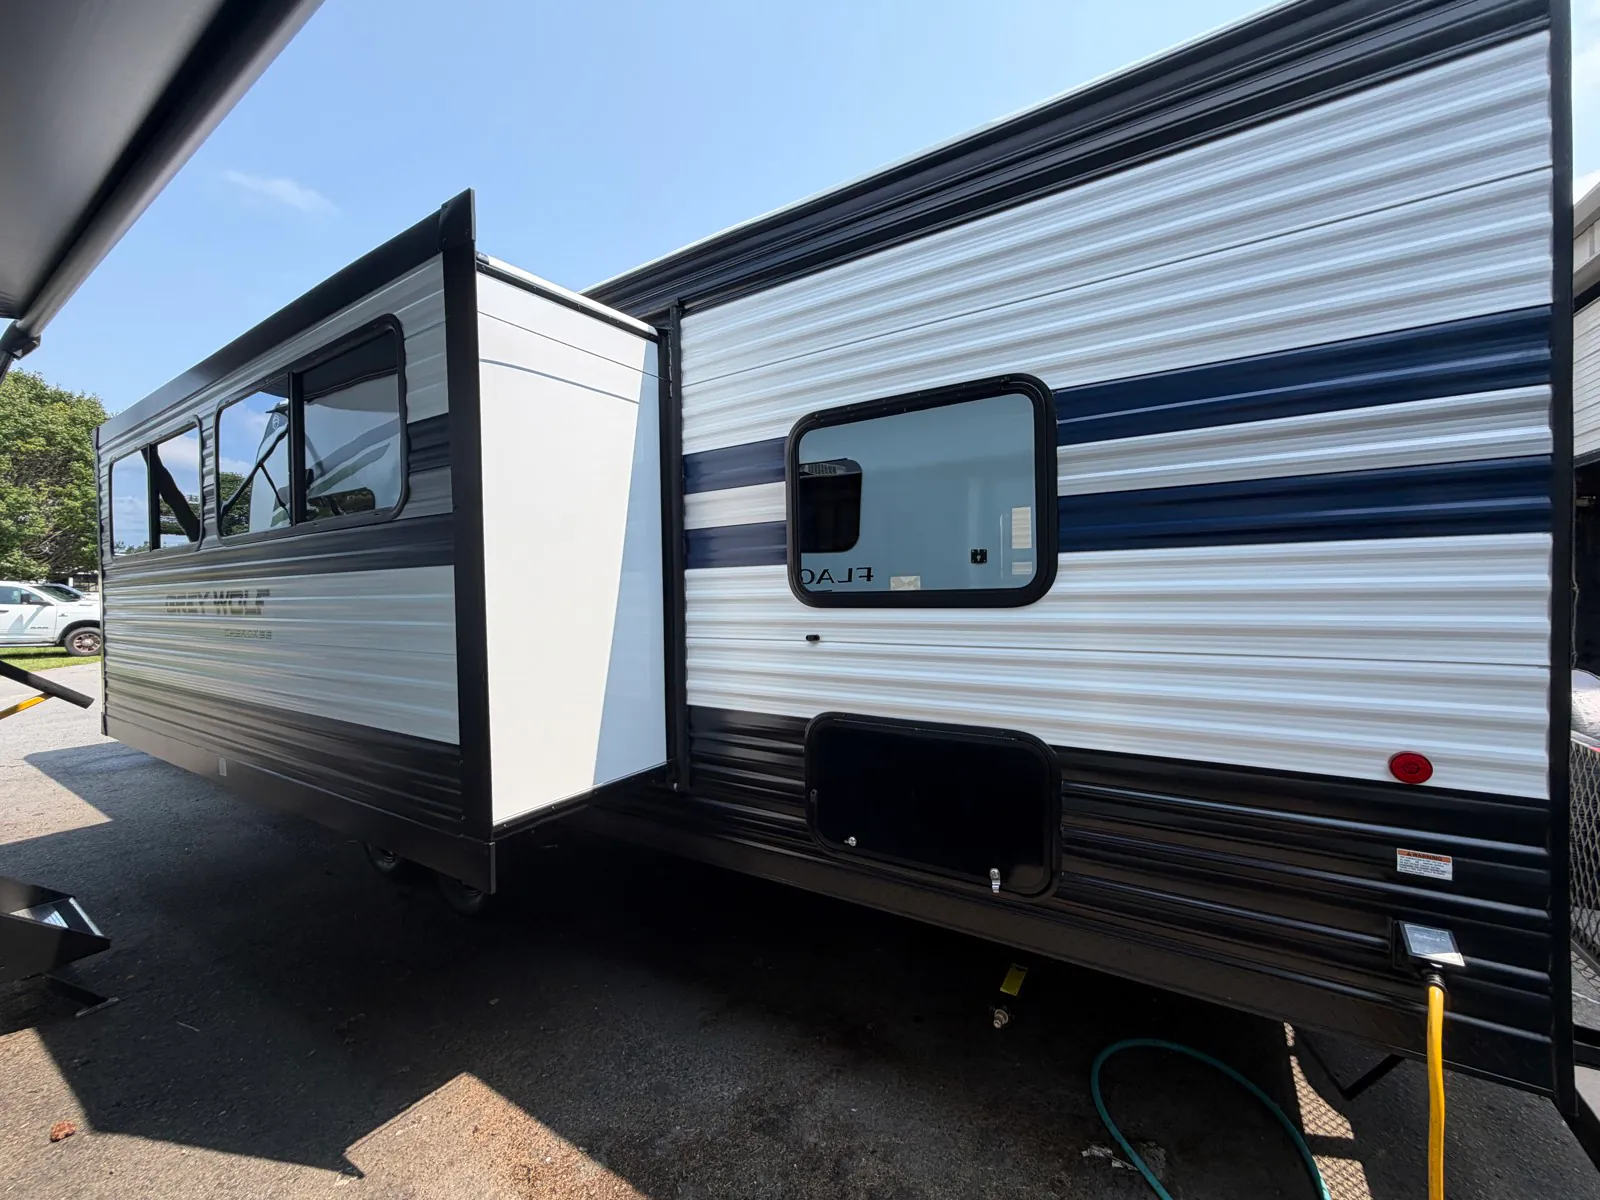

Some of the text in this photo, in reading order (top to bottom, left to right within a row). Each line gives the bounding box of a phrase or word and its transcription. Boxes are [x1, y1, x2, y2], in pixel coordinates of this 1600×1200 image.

[165, 589, 270, 615] GREY WOLF
[1411, 852, 1443, 861] WARNING
